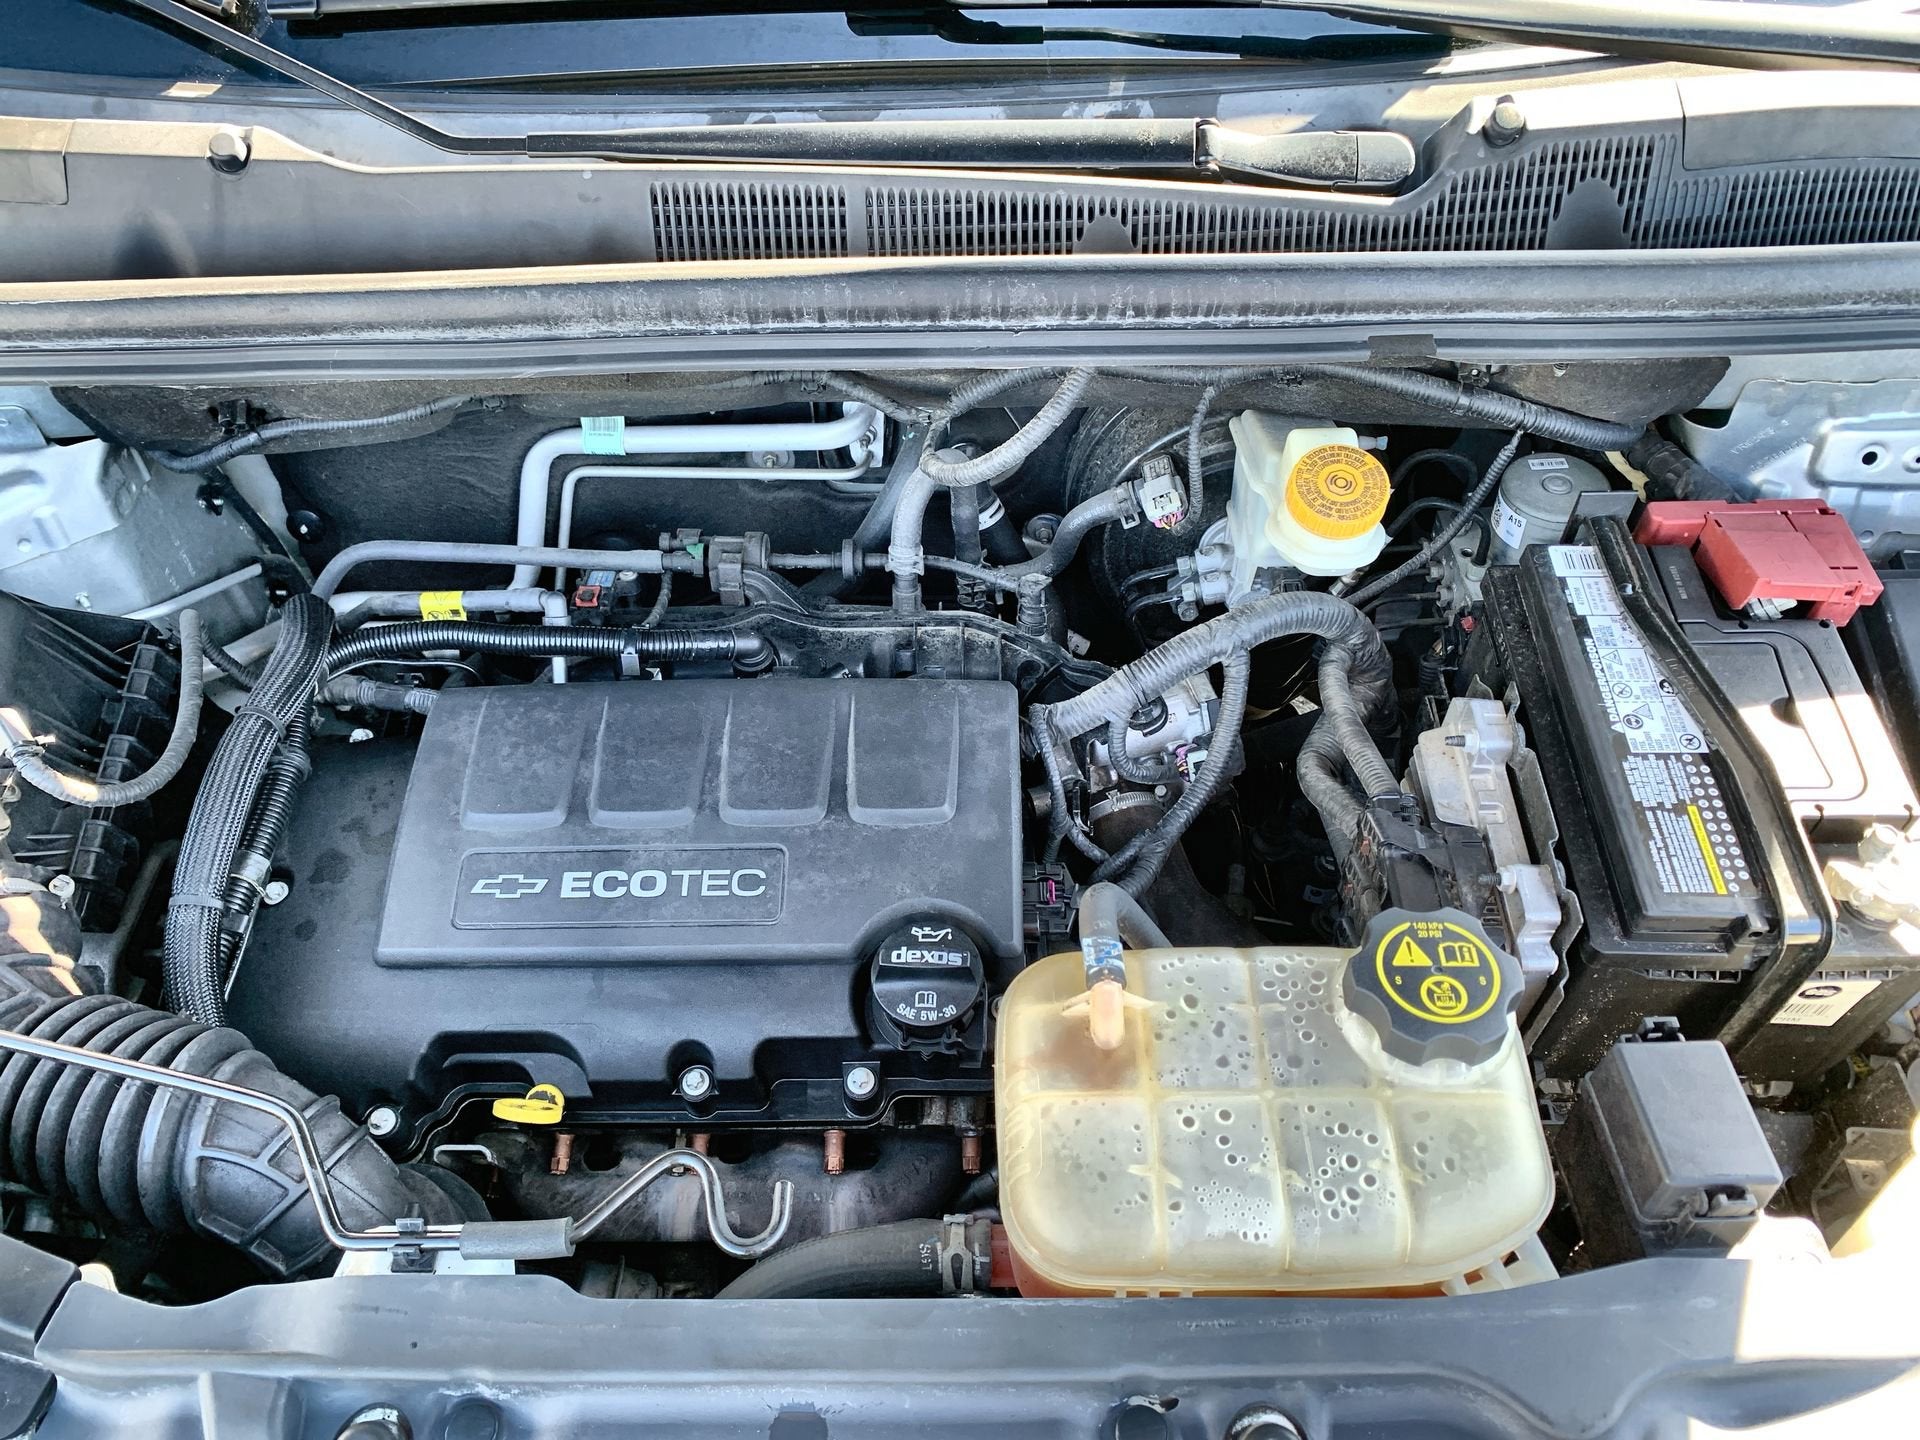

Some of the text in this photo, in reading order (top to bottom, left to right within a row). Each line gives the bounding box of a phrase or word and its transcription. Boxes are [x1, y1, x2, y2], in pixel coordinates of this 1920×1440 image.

[1508, 515, 1522, 528] A15
[1584, 638, 1620, 722] DANGER/POISON
[560, 869, 767, 898] ECOTEC
[1412, 922, 1443, 930] 140 kPa
[1418, 930, 1443, 938] 20 PSI
[896, 1003, 957, 1021] SAE 5W-30
